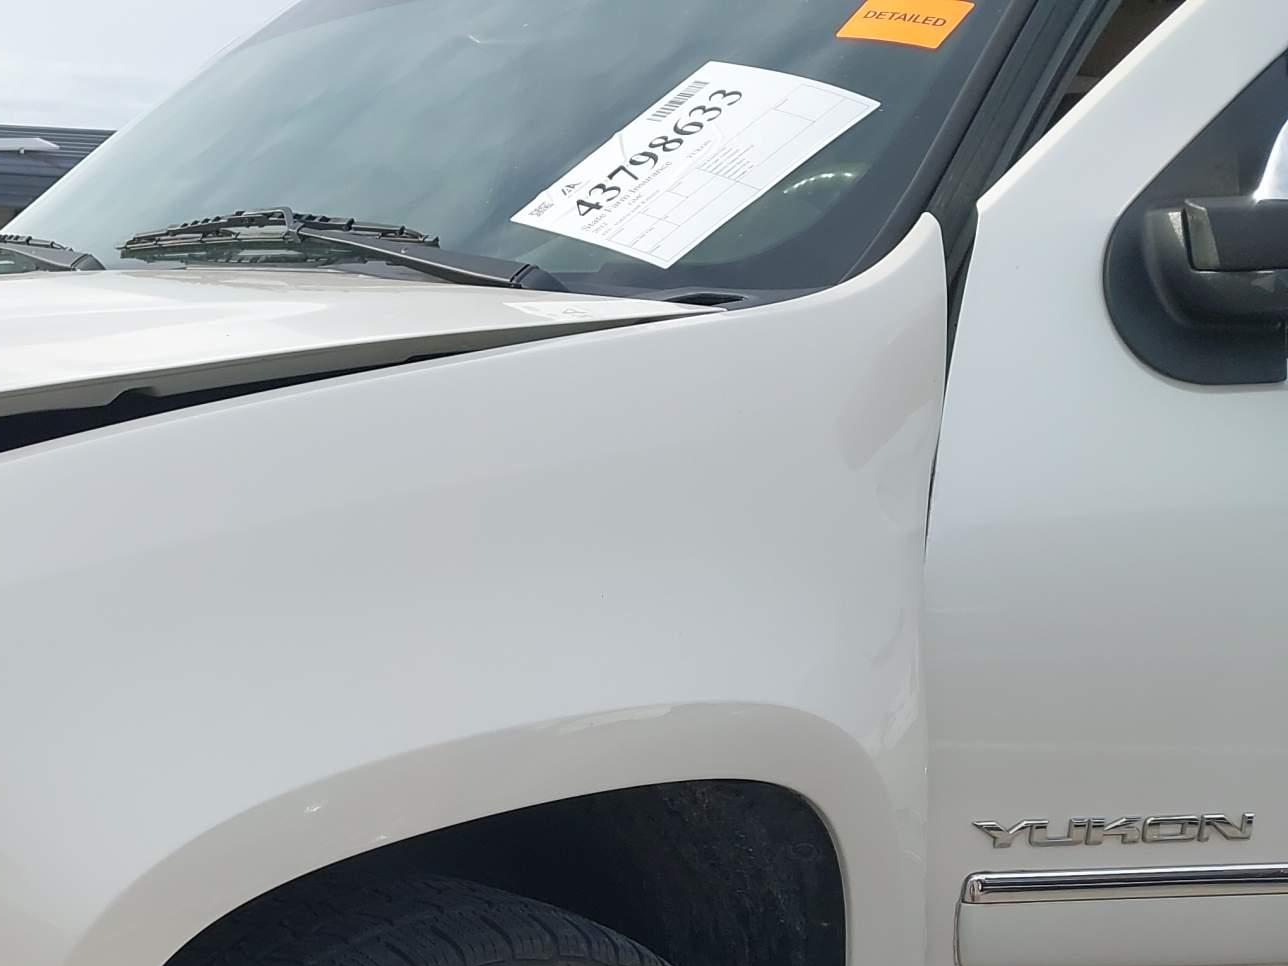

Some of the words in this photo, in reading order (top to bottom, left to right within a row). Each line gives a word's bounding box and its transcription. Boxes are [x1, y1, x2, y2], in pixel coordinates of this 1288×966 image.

[863, 10, 947, 27] DETAILED
[576, 87, 742, 217] 43798633
[578, 212, 608, 232] State
[602, 193, 632, 213] Farm
[971, 812, 1255, 849] YUKON
